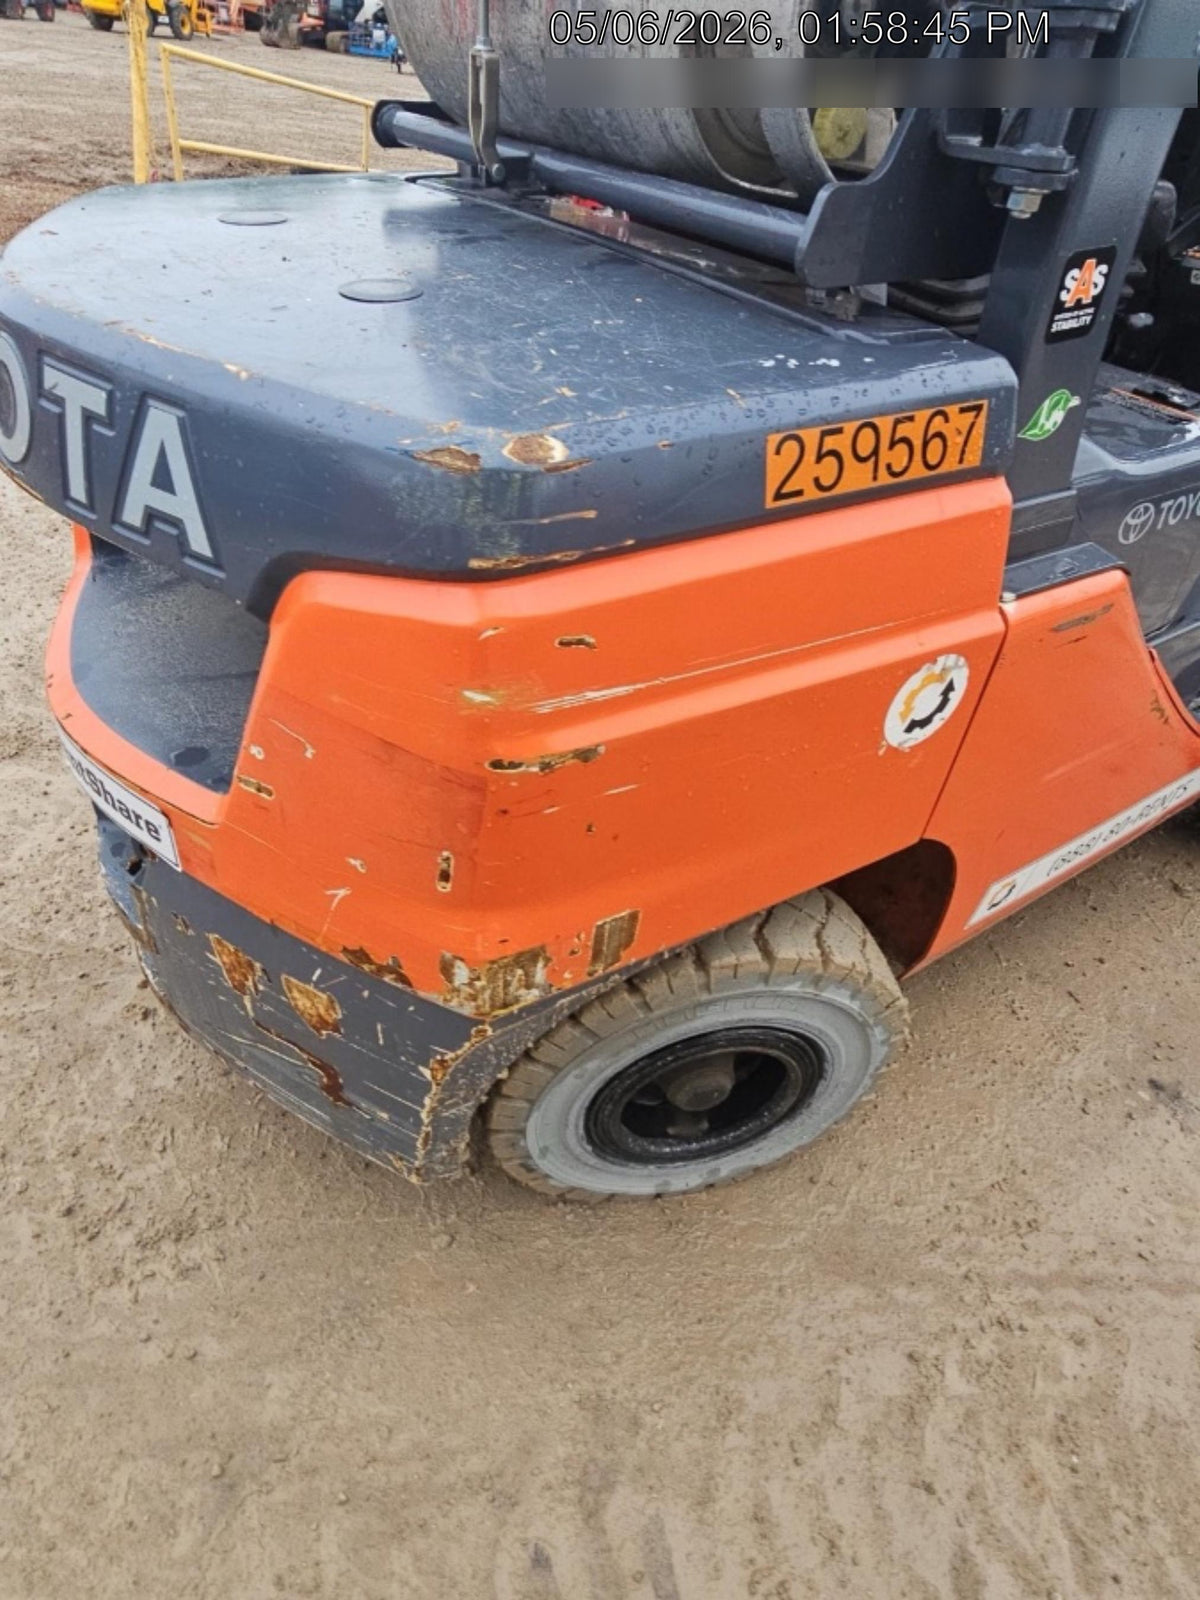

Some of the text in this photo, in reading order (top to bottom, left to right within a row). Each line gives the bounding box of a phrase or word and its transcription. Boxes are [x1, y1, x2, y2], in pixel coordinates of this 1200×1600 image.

[1060, 258, 1109, 308] SAS
[772, 402, 984, 503] 259567
[1156, 490, 1200, 531] TOY
